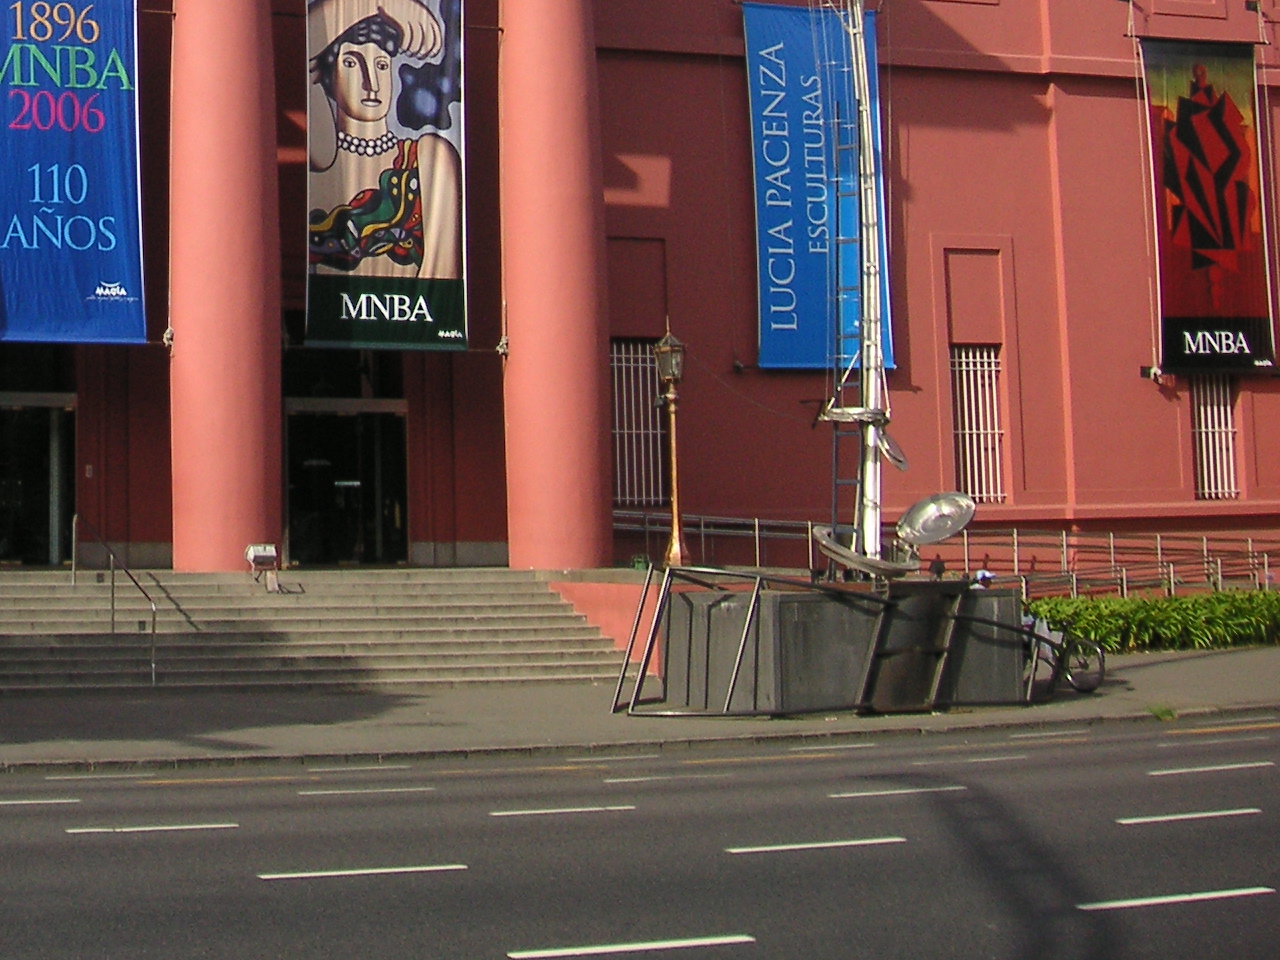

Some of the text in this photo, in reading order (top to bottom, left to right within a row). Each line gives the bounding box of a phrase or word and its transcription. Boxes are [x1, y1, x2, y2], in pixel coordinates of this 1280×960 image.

[9, 1, 100, 44] 1896
[8, 90, 106, 133] 2006
[28, 163, 88, 205] 110
[801, 74, 829, 255] ESCULTURAS
[759, 42, 797, 331] LUCIA PACENZA
[0, 206, 117, 251] AÑOS
[340, 293, 433, 322] MNBA
[1183, 331, 1251, 354] MNBA
